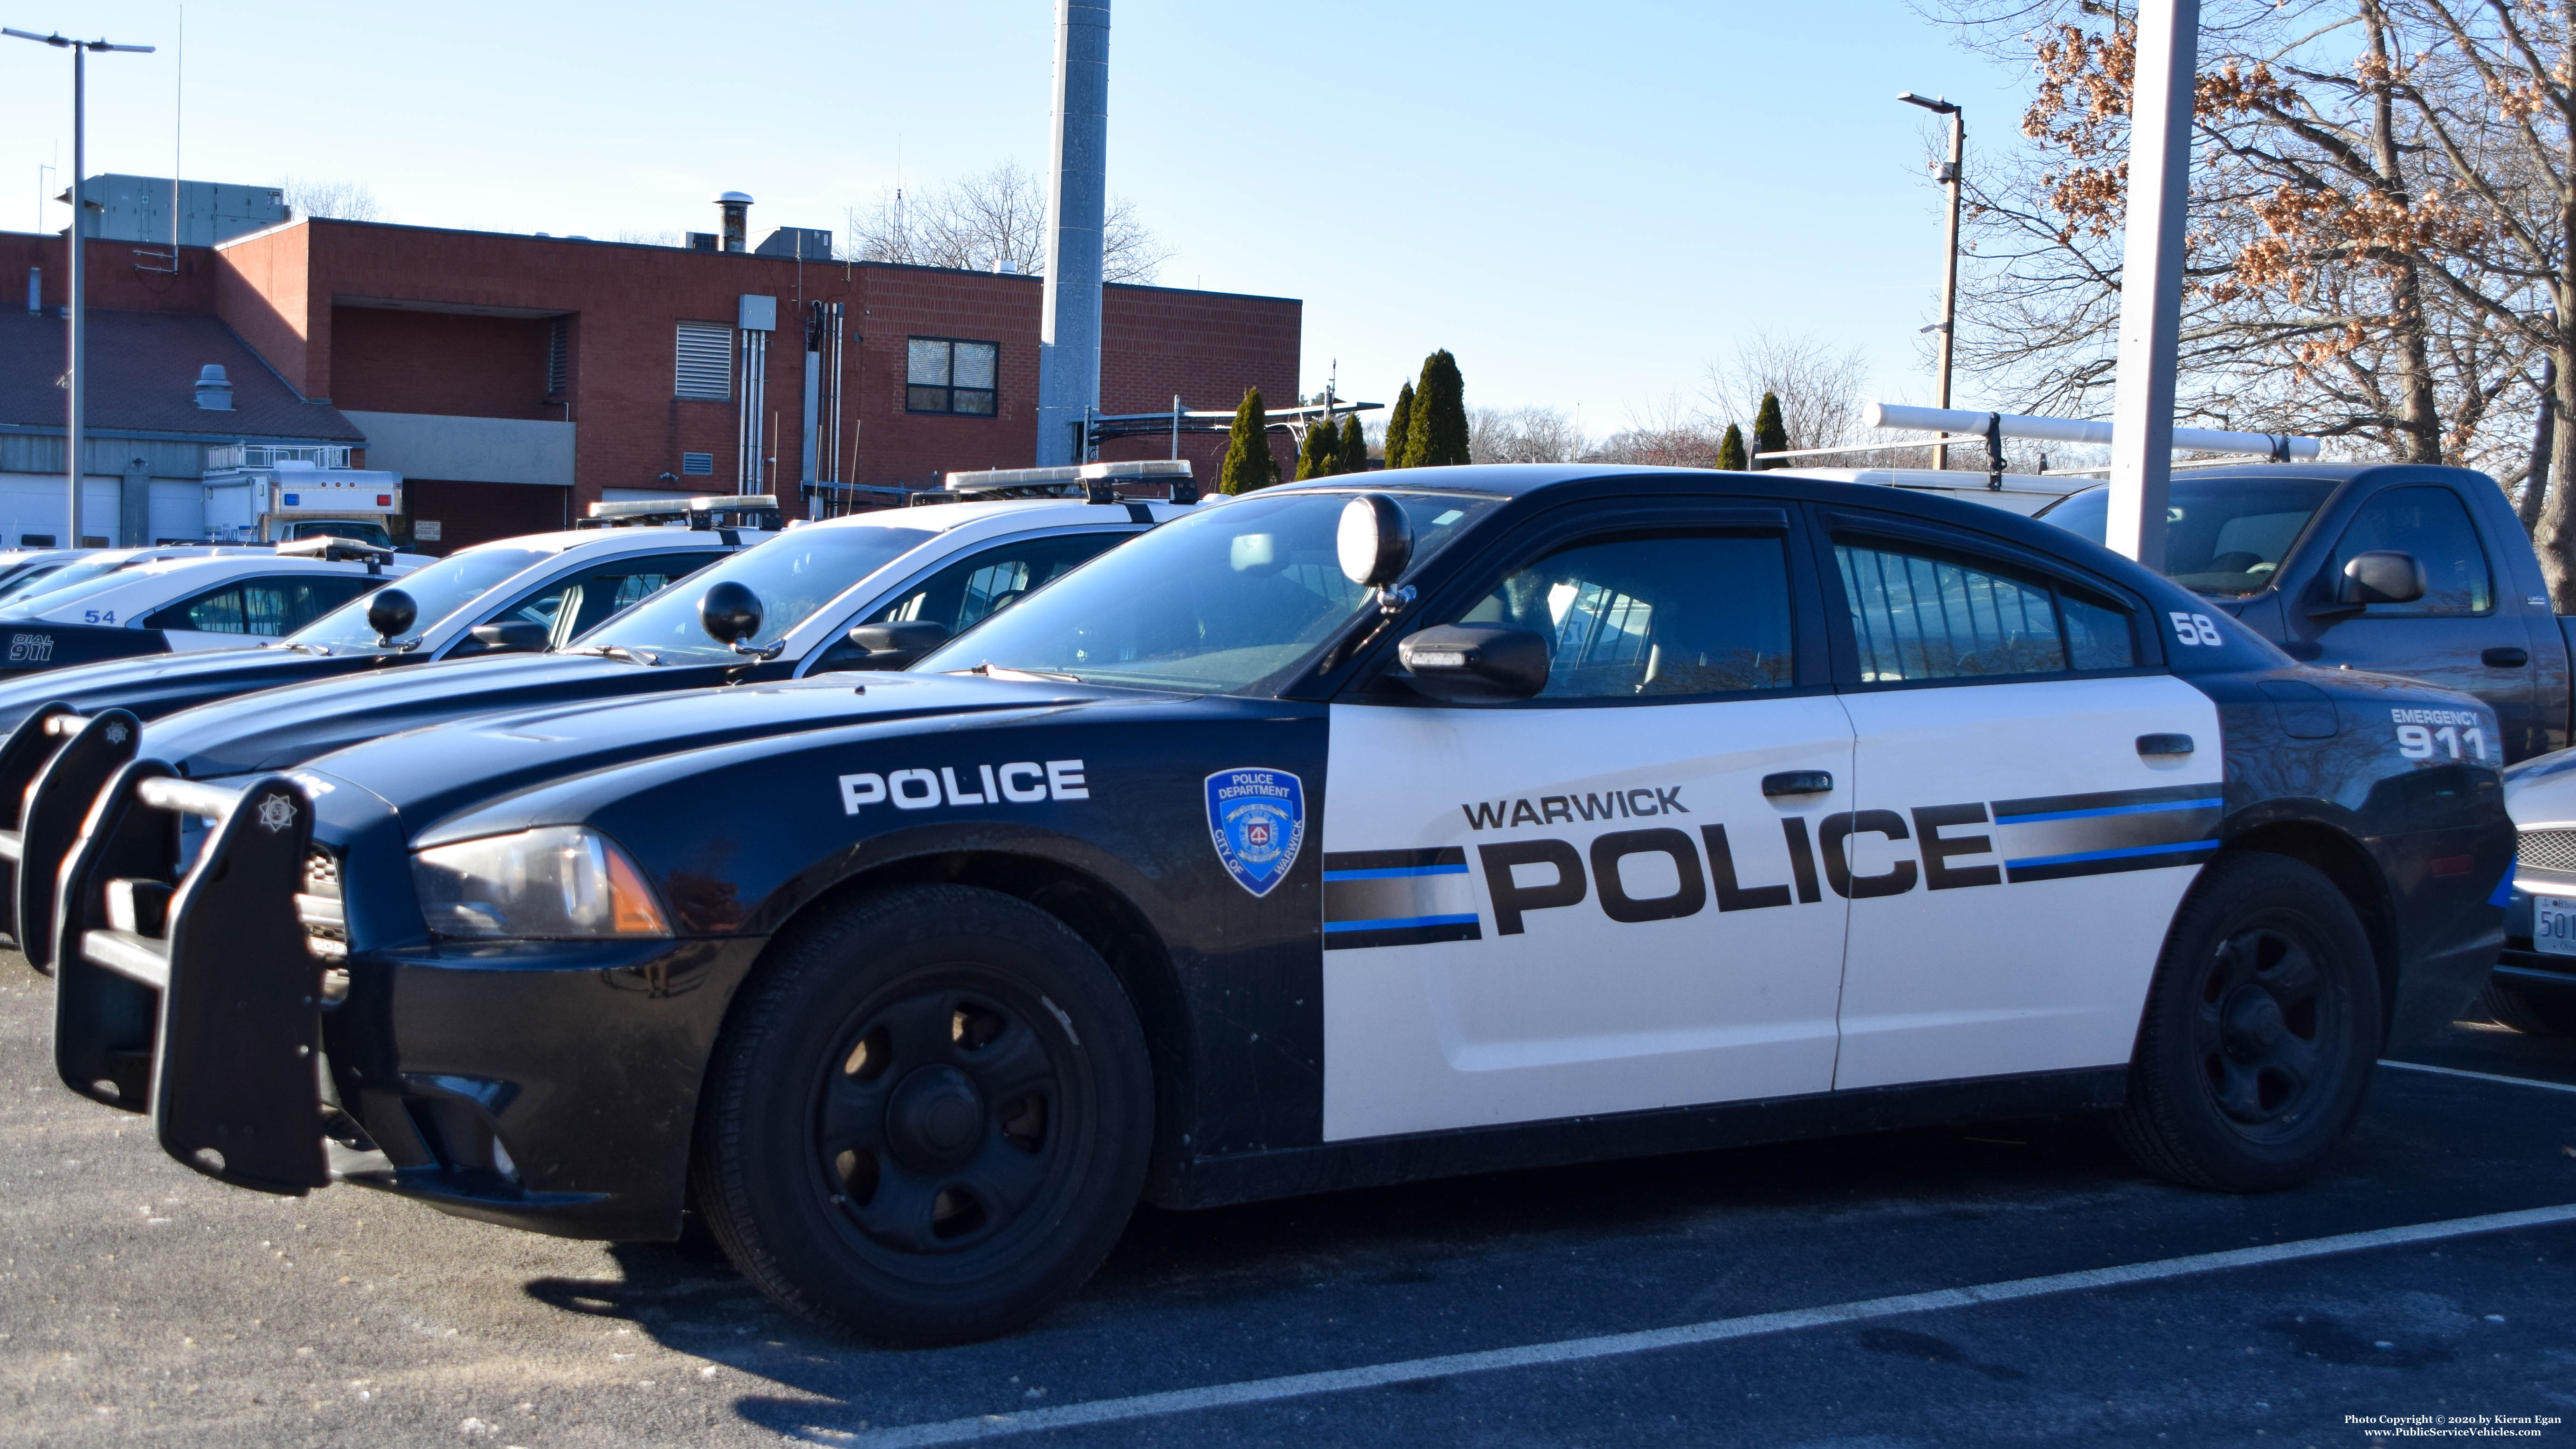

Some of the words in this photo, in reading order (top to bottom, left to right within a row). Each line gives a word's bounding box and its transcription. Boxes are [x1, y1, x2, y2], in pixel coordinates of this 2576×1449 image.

[85, 610, 116, 624] 54
[2169, 612, 2222, 646] 58
[10, 643, 52, 661] 911
[13, 634, 54, 644] DIAL
[2391, 709, 2478, 725] EMERGENCY
[2396, 725, 2485, 759] 911
[839, 759, 1090, 816] POLICE
[1218, 785, 1290, 799] DEPARTMENT
[1232, 773, 1274, 784] POLICE
[1461, 786, 1691, 830] WARWICK
[1215, 829, 1232, 856] CITY
[1229, 859, 1244, 874] OF
[1274, 820, 1302, 875] WARWICK
[1477, 801, 2002, 936] POLICE
